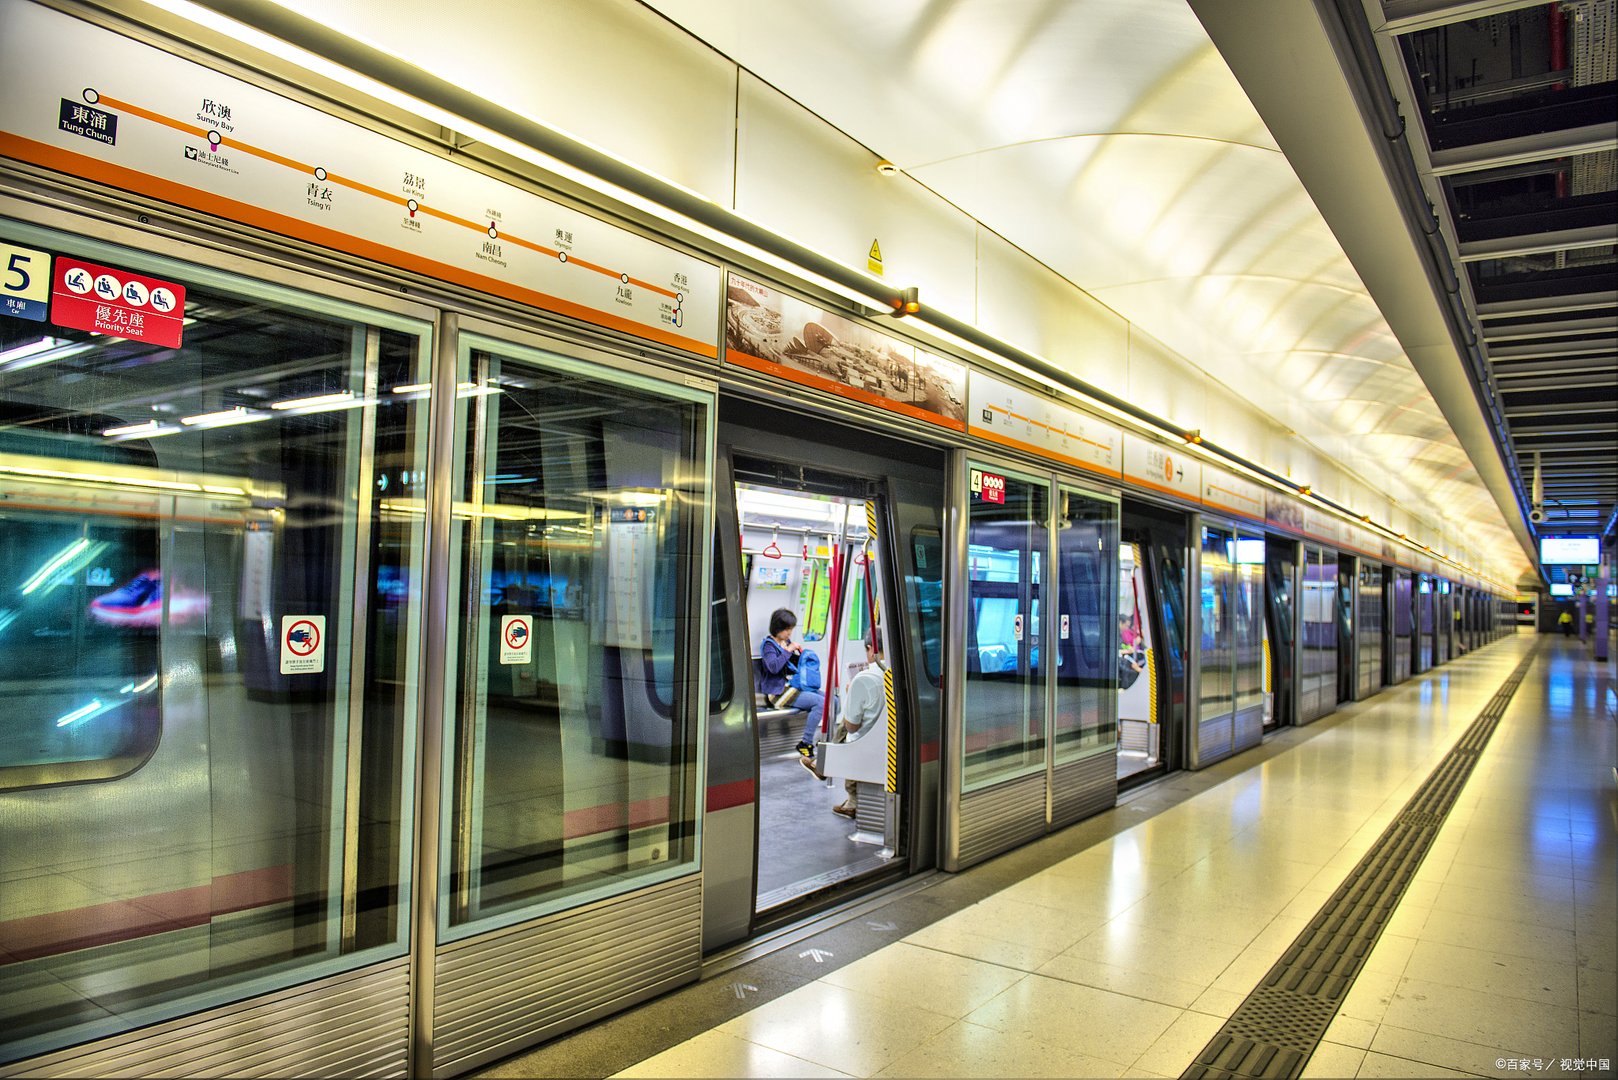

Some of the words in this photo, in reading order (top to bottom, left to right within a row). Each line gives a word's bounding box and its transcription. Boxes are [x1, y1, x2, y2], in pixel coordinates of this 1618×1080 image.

[71, 105, 107, 130] 東涌
[201, 98, 232, 121] 欣澳
[62, 119, 84, 135] Tung
[85, 128, 113, 144] Chung
[196, 112, 220, 128] Sunny
[221, 121, 235, 133] Bay
[403, 171, 425, 190] 荔景
[306, 182, 333, 202] 青衣
[411, 189, 425, 199] King
[307, 197, 324, 210] Tsing
[324, 203, 331, 211] Yi
[482, 241, 502, 258] 南昌
[475, 252, 488, 261] Nam
[488, 256, 507, 268] Cheong
[4, 253, 31, 291] 5
[616, 285, 632, 300] 九龍
[6, 298, 26, 310] 車廂
[95, 304, 145, 328] 優先座
[95, 320, 125, 334] Priority
[126, 326, 144, 336] Seat
[974, 474, 979, 488] 4
